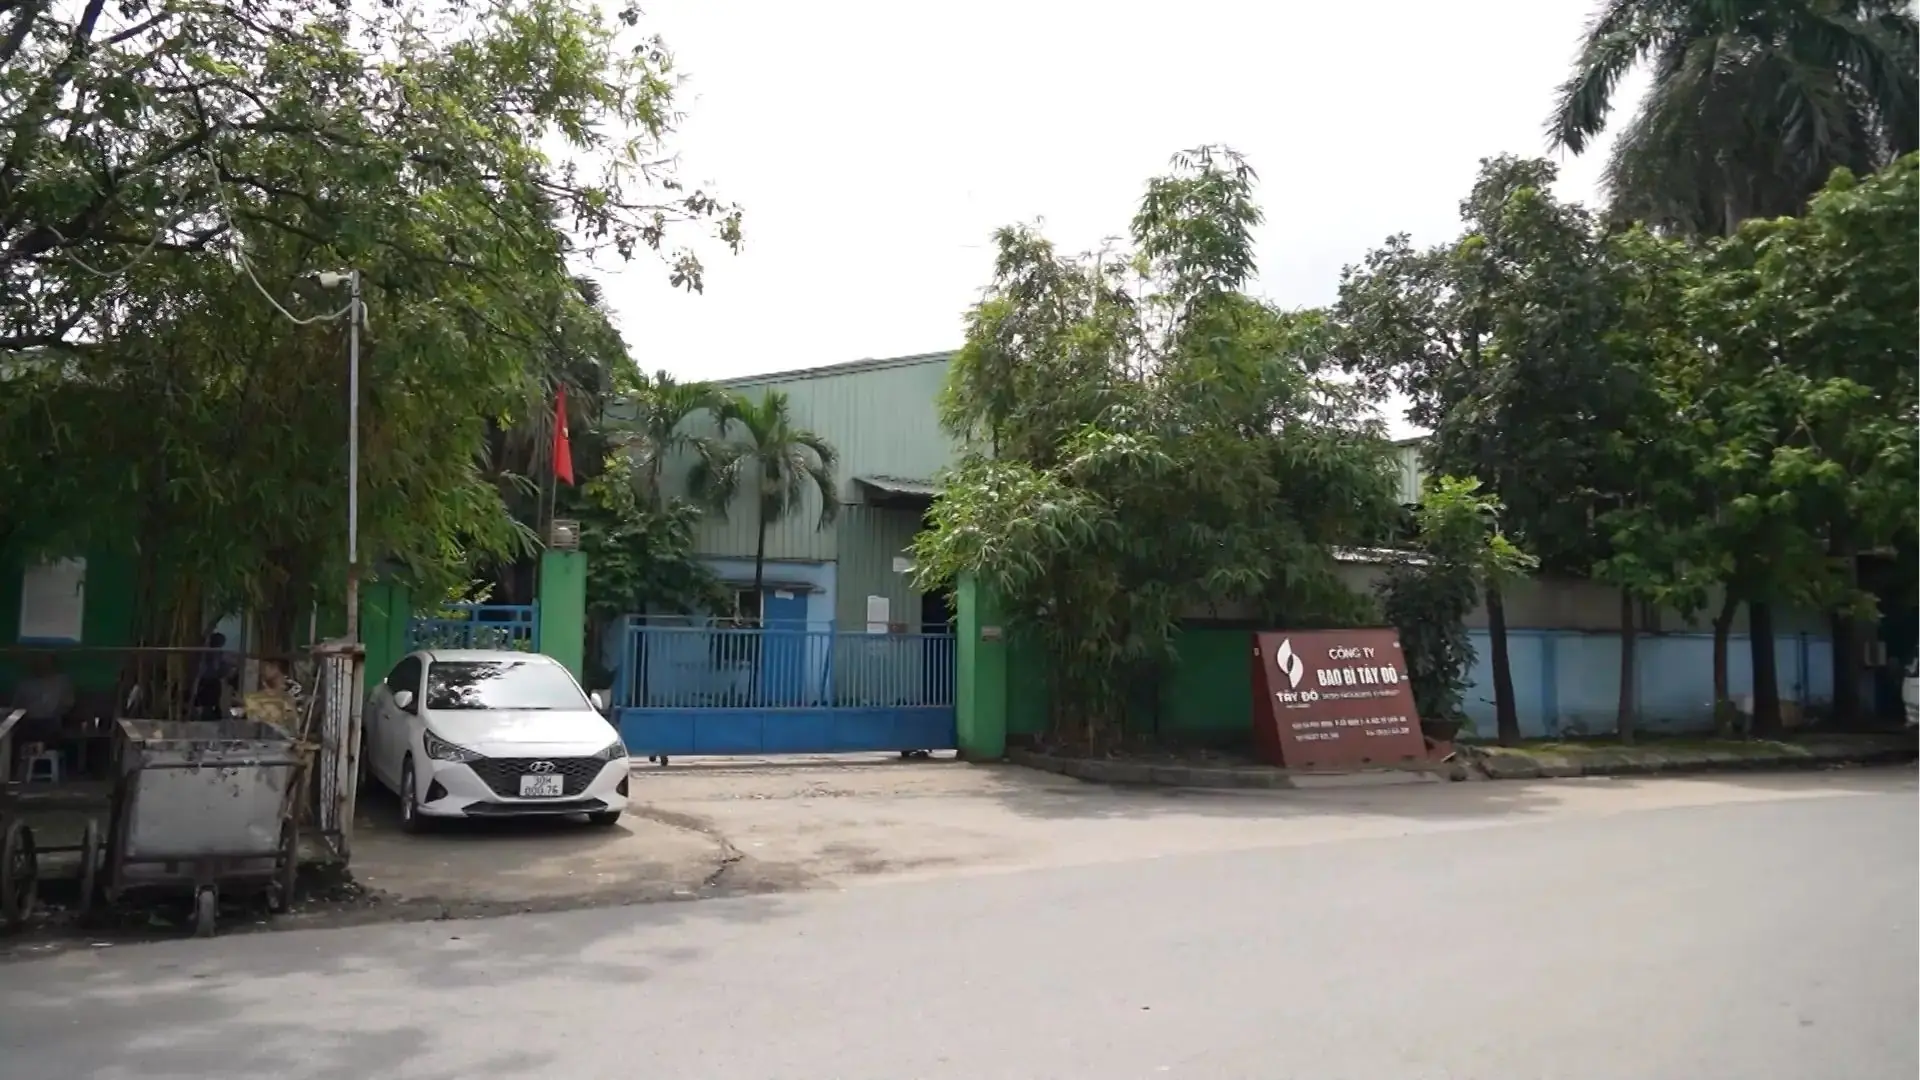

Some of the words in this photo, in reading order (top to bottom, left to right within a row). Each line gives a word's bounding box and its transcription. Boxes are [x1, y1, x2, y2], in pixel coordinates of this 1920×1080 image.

[1329, 645, 1361, 660] CÔNG
[1362, 647, 1375, 658] TY
[1317, 668, 1342, 686] BAO
[1343, 665, 1357, 685] BÌ
